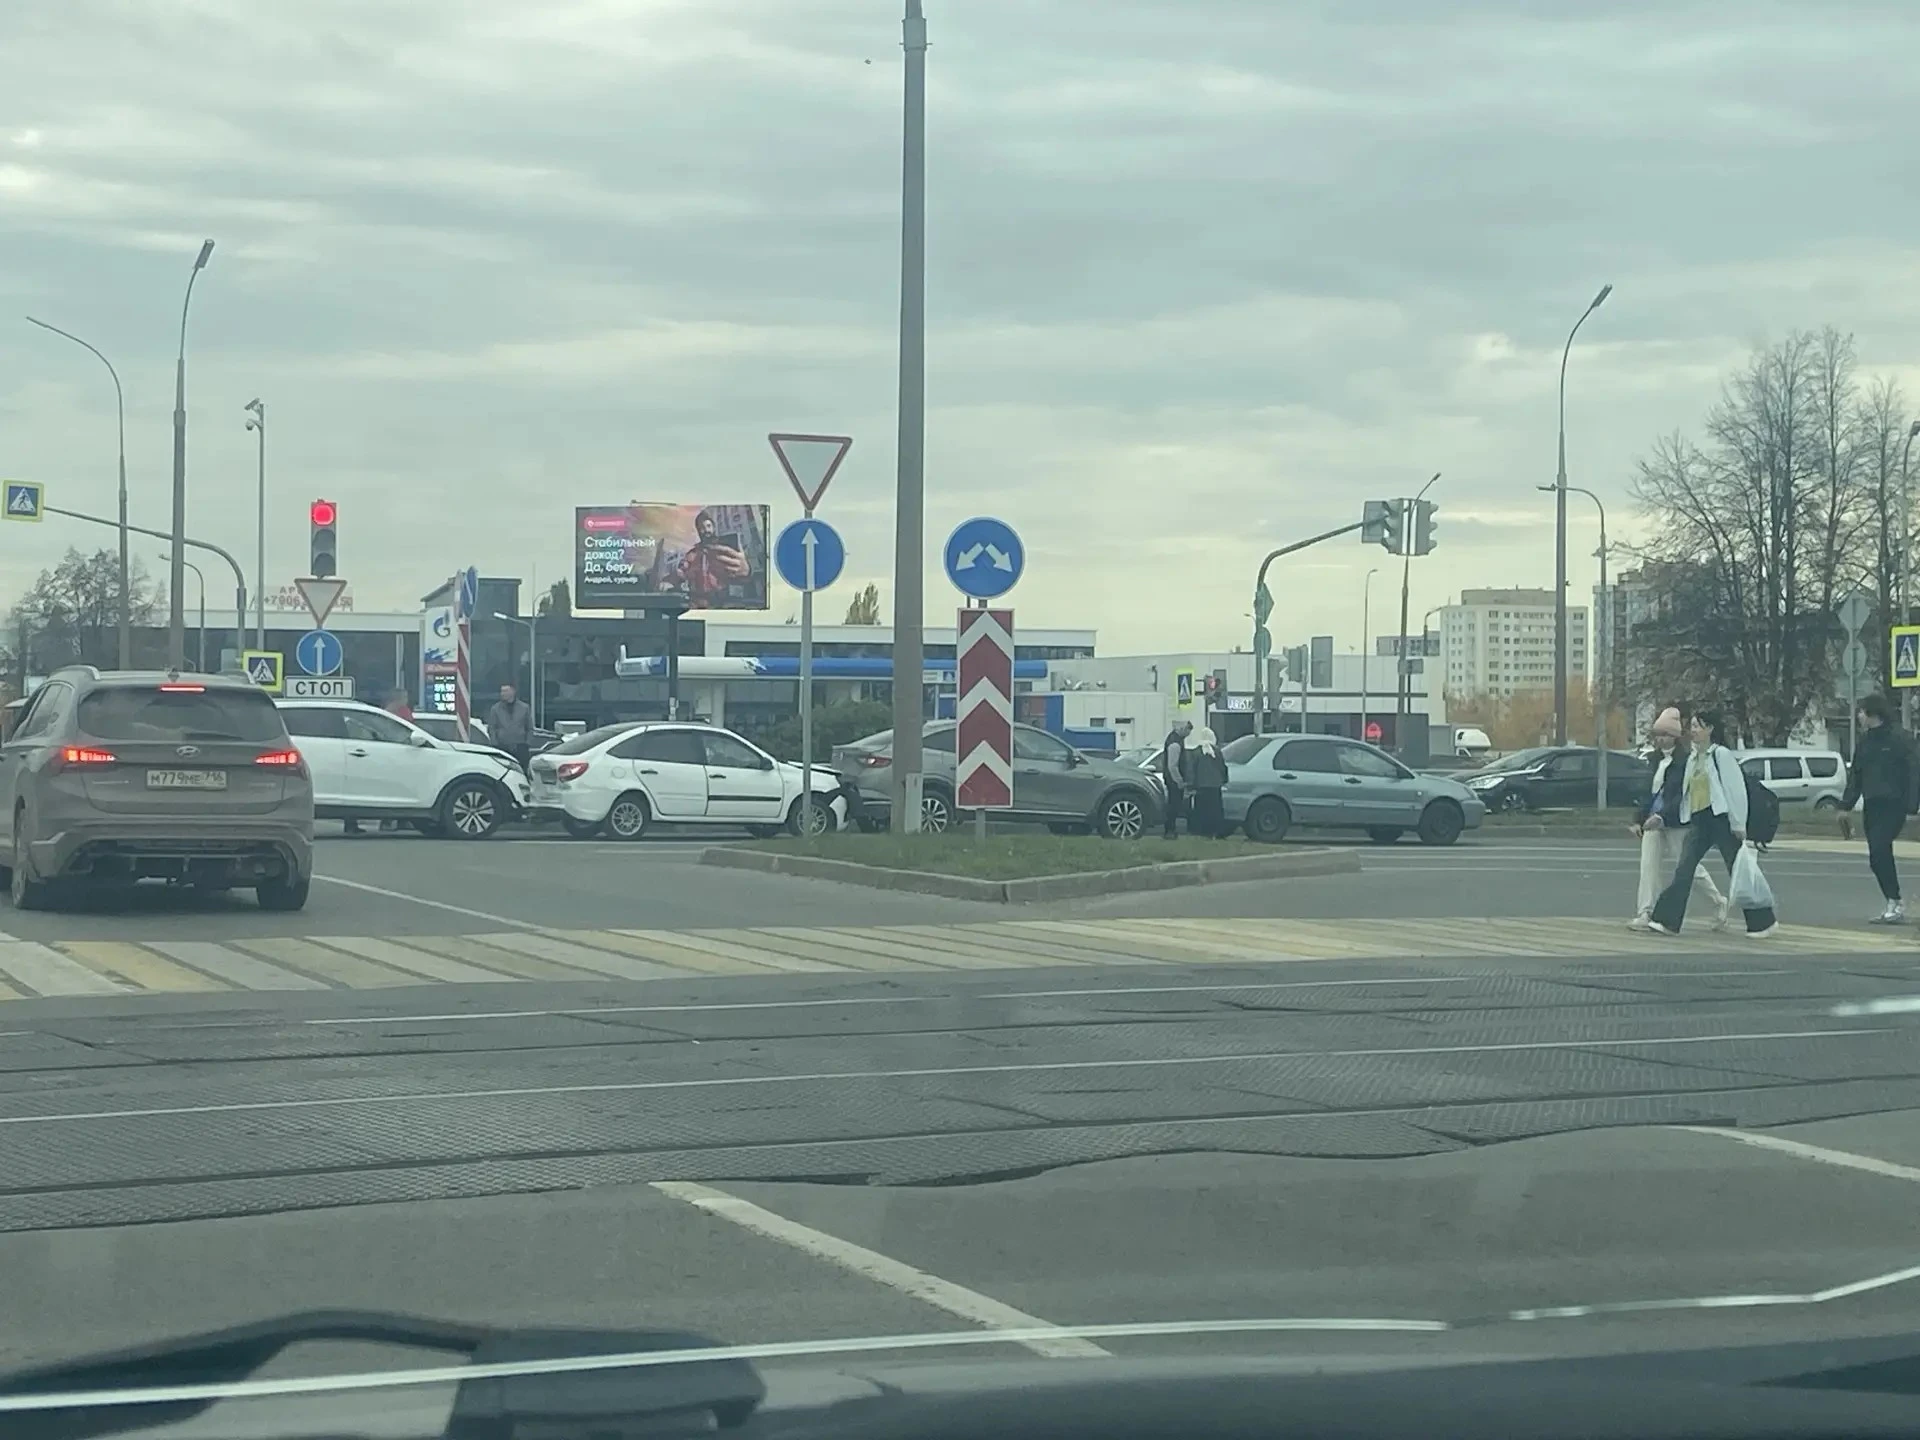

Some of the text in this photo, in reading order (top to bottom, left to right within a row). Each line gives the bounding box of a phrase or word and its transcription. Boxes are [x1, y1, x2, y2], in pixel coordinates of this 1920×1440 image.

[584, 536, 656, 548] Стабильный
[584, 549, 625, 561] доход?
[584, 561, 634, 574] Да, беру
[295, 681, 344, 695] СТОП
